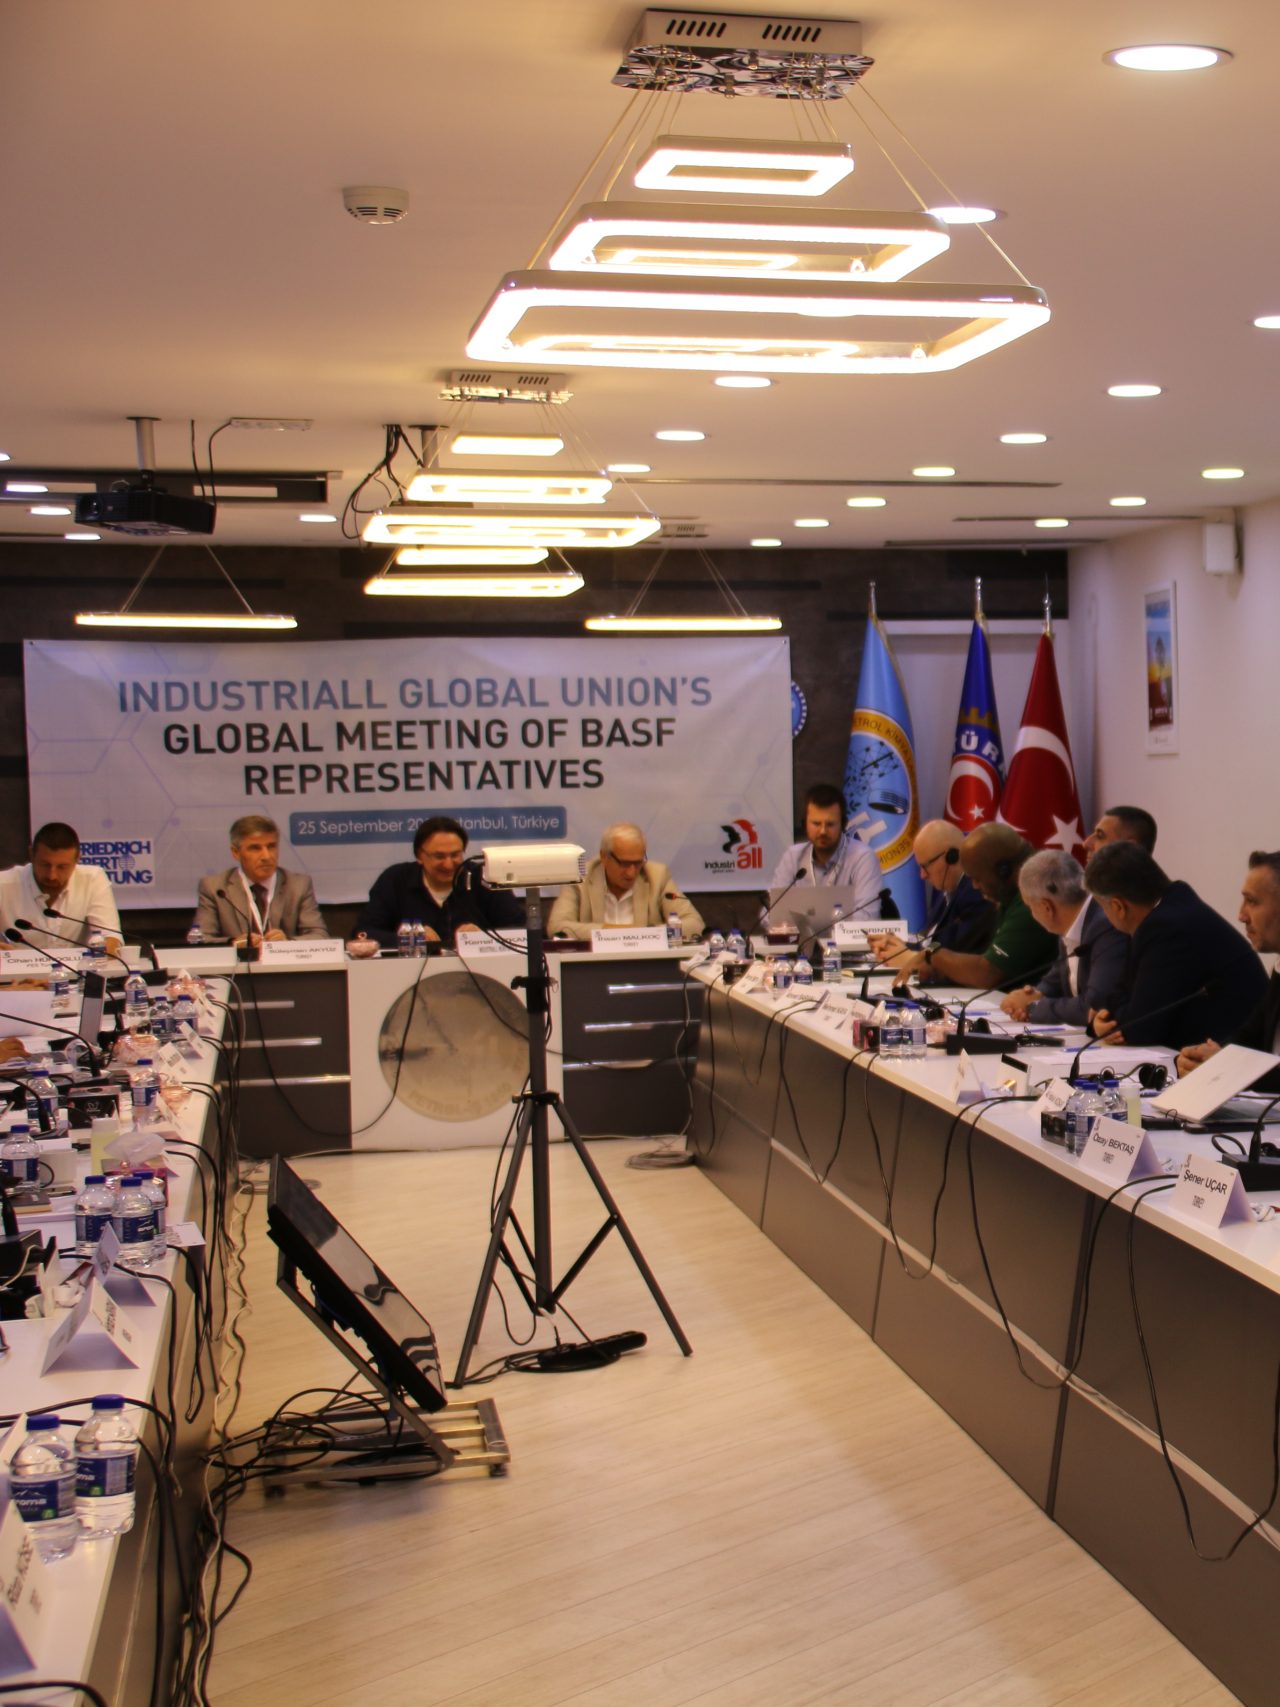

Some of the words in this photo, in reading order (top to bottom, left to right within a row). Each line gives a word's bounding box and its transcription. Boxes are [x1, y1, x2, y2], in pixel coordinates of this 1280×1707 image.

[119, 678, 388, 713] INDUSTRIALL
[399, 677, 549, 709] GLOBAL
[560, 676, 712, 707] UNION'S
[163, 722, 323, 754] GLOBAL
[336, 718, 509, 751] MEETING
[521, 718, 568, 749] OF
[581, 718, 676, 748] BASF
[244, 758, 605, 796] REPRESENTATIVES
[298, 820, 316, 835] 25
[319, 820, 404, 838] September
[512, 814, 560, 831] Türkiye
[1205, 1177, 1228, 1195] UÇAR
